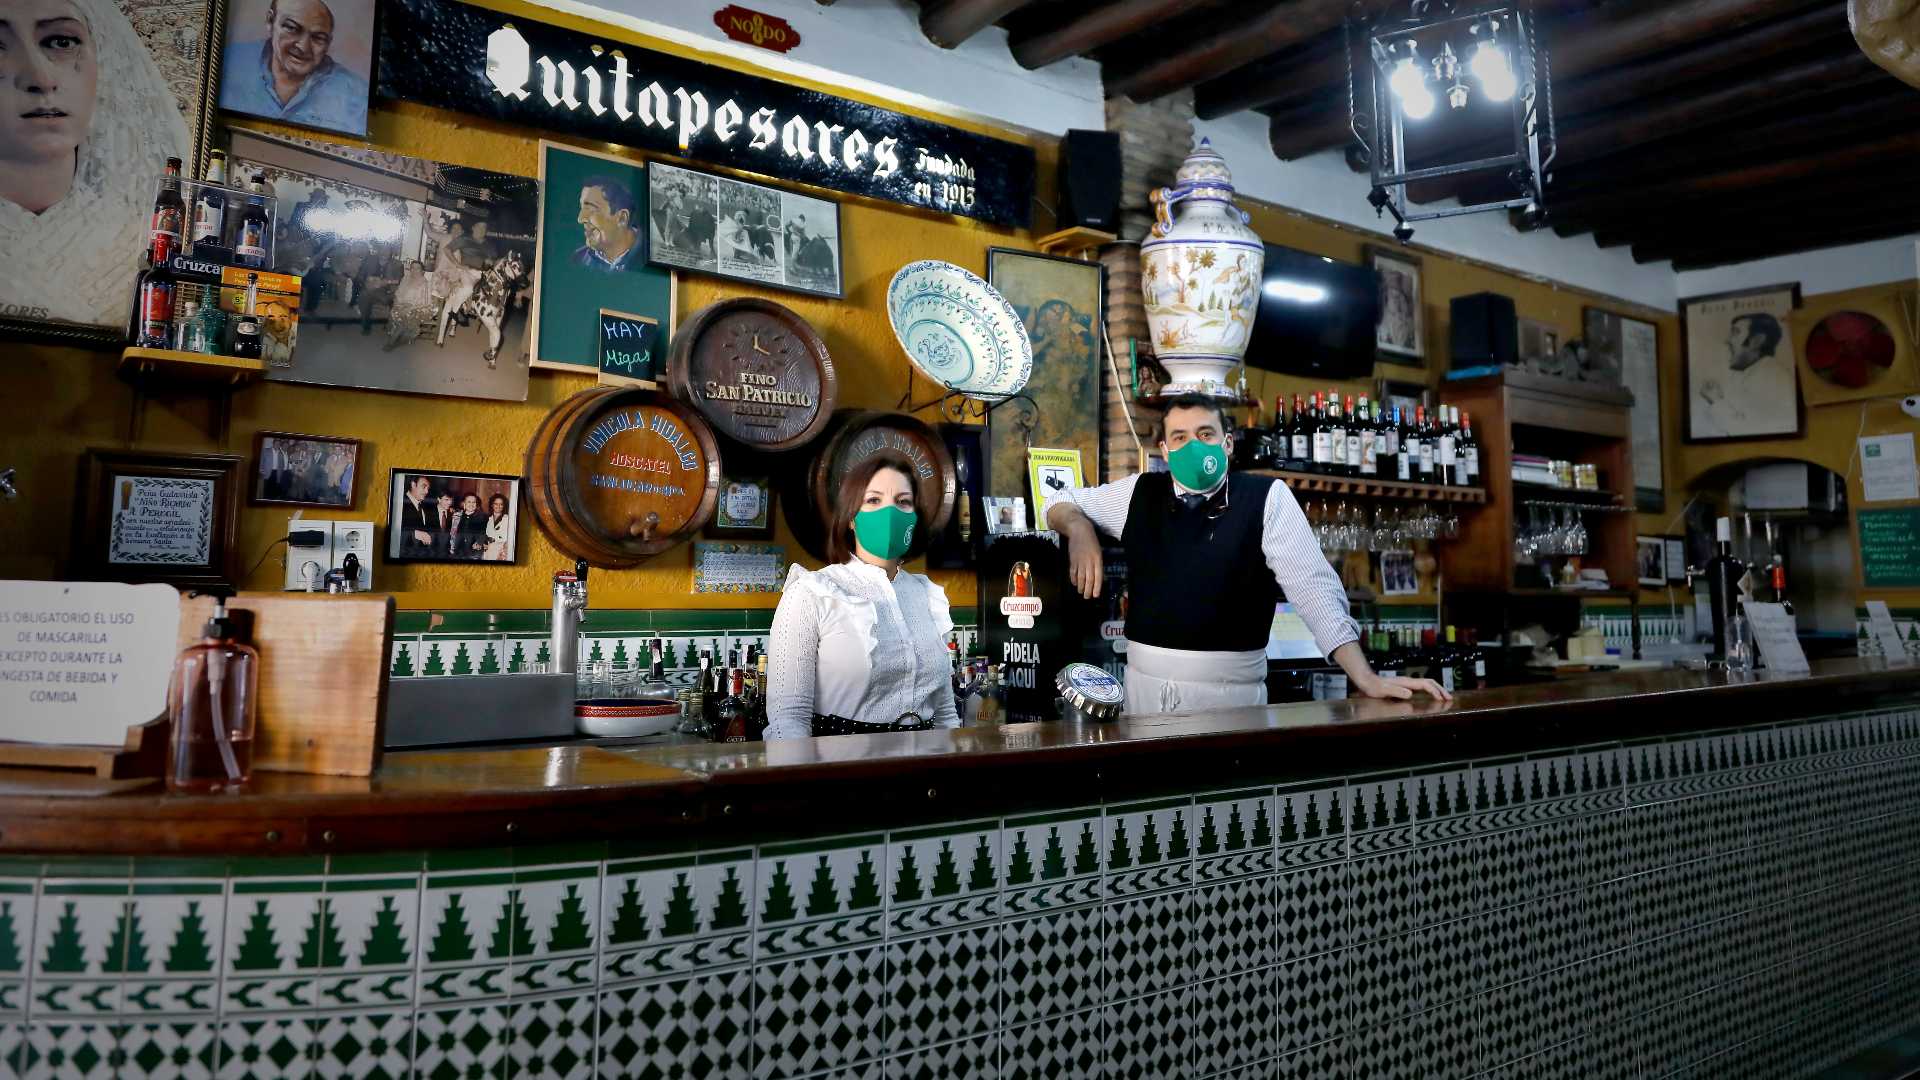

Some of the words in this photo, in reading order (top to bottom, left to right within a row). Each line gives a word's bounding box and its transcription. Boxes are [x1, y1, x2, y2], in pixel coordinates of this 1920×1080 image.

[485, 23, 900, 179] Quitapesares
[915, 147, 976, 181] Fundada
[915, 181, 931, 201] en
[174, 256, 222, 276] Cruzca
[603, 322, 645, 340] HAY
[605, 349, 650, 372] Migas
[740, 372, 777, 386] FINO
[743, 384, 812, 407] PATRICIO
[609, 450, 672, 476] MOSCATEL
[1003, 600, 1040, 614] Cruzcampo
[13, 611, 91, 624] OBLIGATORIO
[94, 612, 106, 624] EL
[110, 612, 135, 625] USO
[17, 631, 32, 643] DE
[36, 631, 108, 644] MASCARILLA
[0, 651, 47, 663] EXCEPTO
[50, 652, 105, 664] DURANTE
[109, 652, 123, 664] LA
[1003, 637, 1041, 665] PÍDELA
[46, 670, 62, 682] DE
[65, 671, 106, 683] BEBIDA
[111, 672, 118, 684] Y
[1008, 662, 1036, 689] AQUÍ
[29, 690, 77, 703] COMIDA
